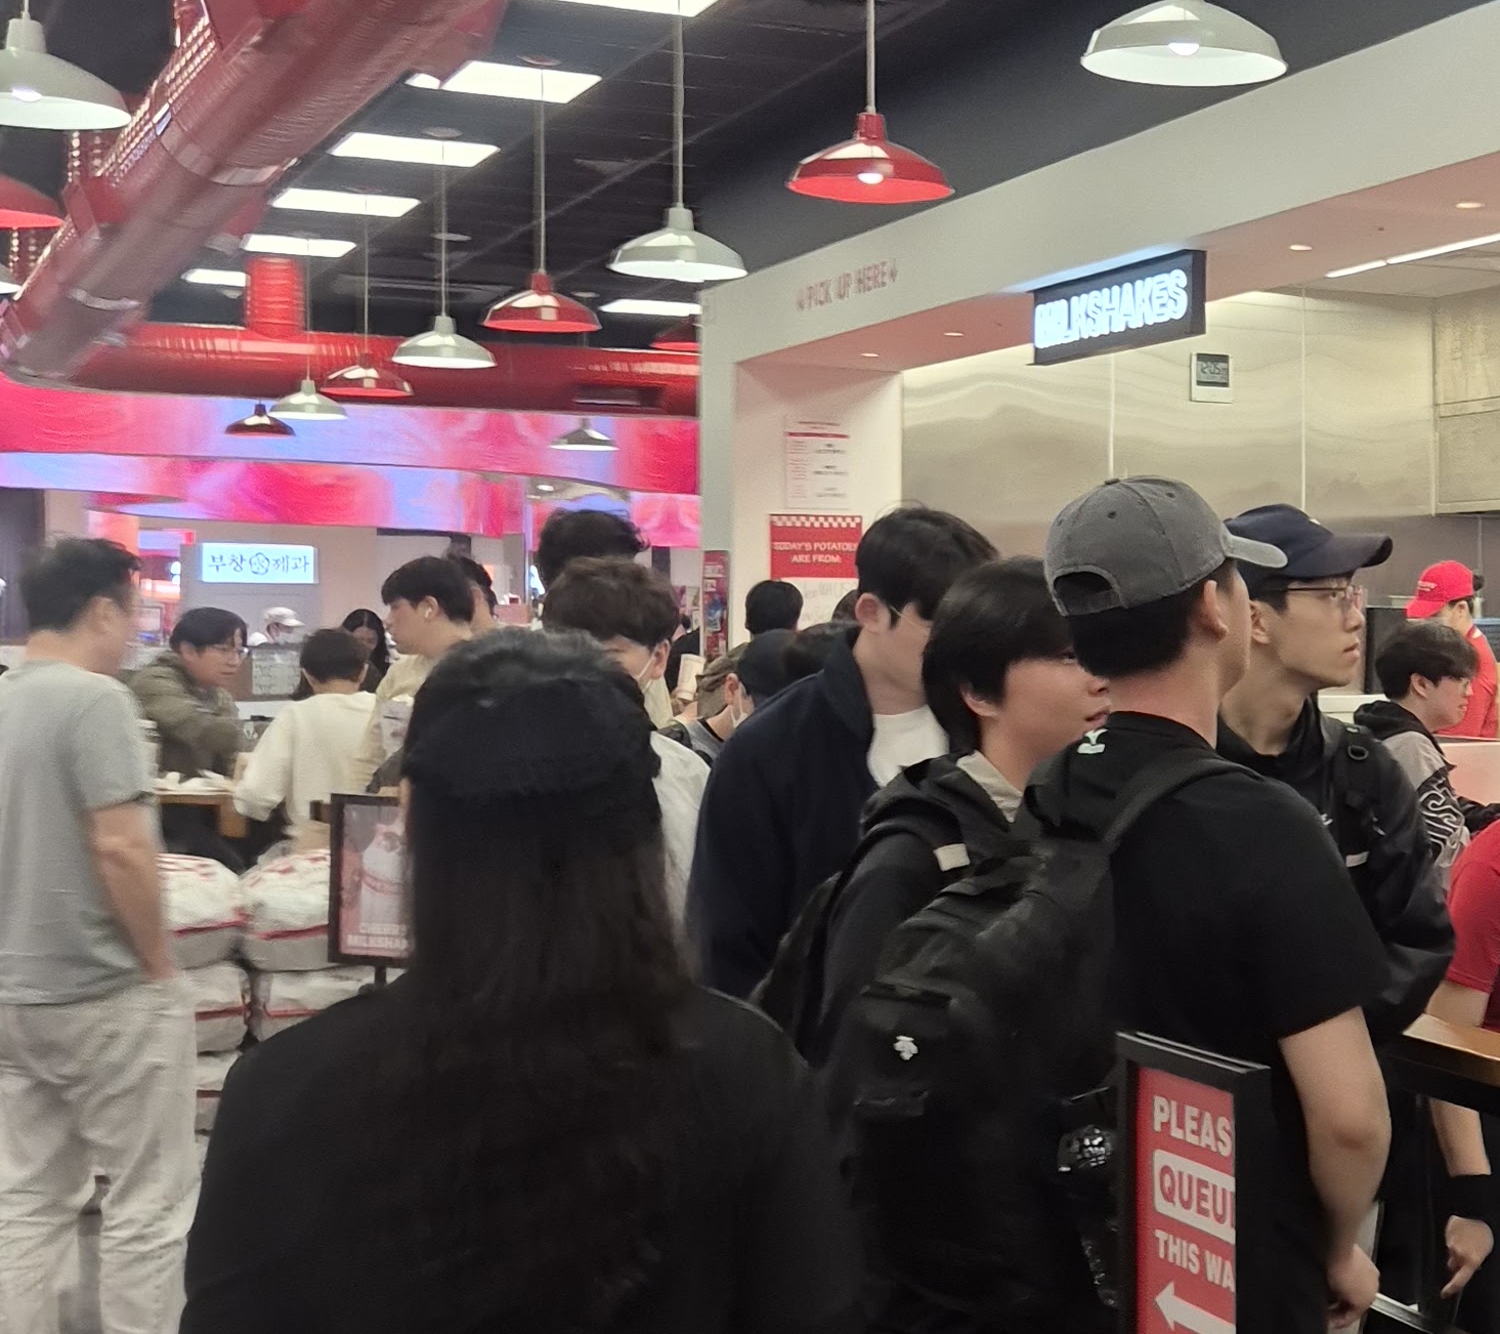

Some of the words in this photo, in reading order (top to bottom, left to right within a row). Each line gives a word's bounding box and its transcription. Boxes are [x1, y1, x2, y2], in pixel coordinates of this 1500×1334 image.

[806, 279, 833, 309] PICK
[837, 272, 852, 299] UP
[856, 261, 887, 294] HERE
[1035, 269, 1187, 349] MILKSHAKES
[208, 554, 246, 573] 부창
[272, 554, 309, 573] 제과
[773, 542, 812, 551] TODAY'S
[791, 554, 810, 563] ARE
[1152, 1095, 1232, 1157] PLEAS
[1158, 1164, 1235, 1228] QUEU
[1154, 1230, 1199, 1275] THIS
[1204, 1249, 1235, 1294] WA
